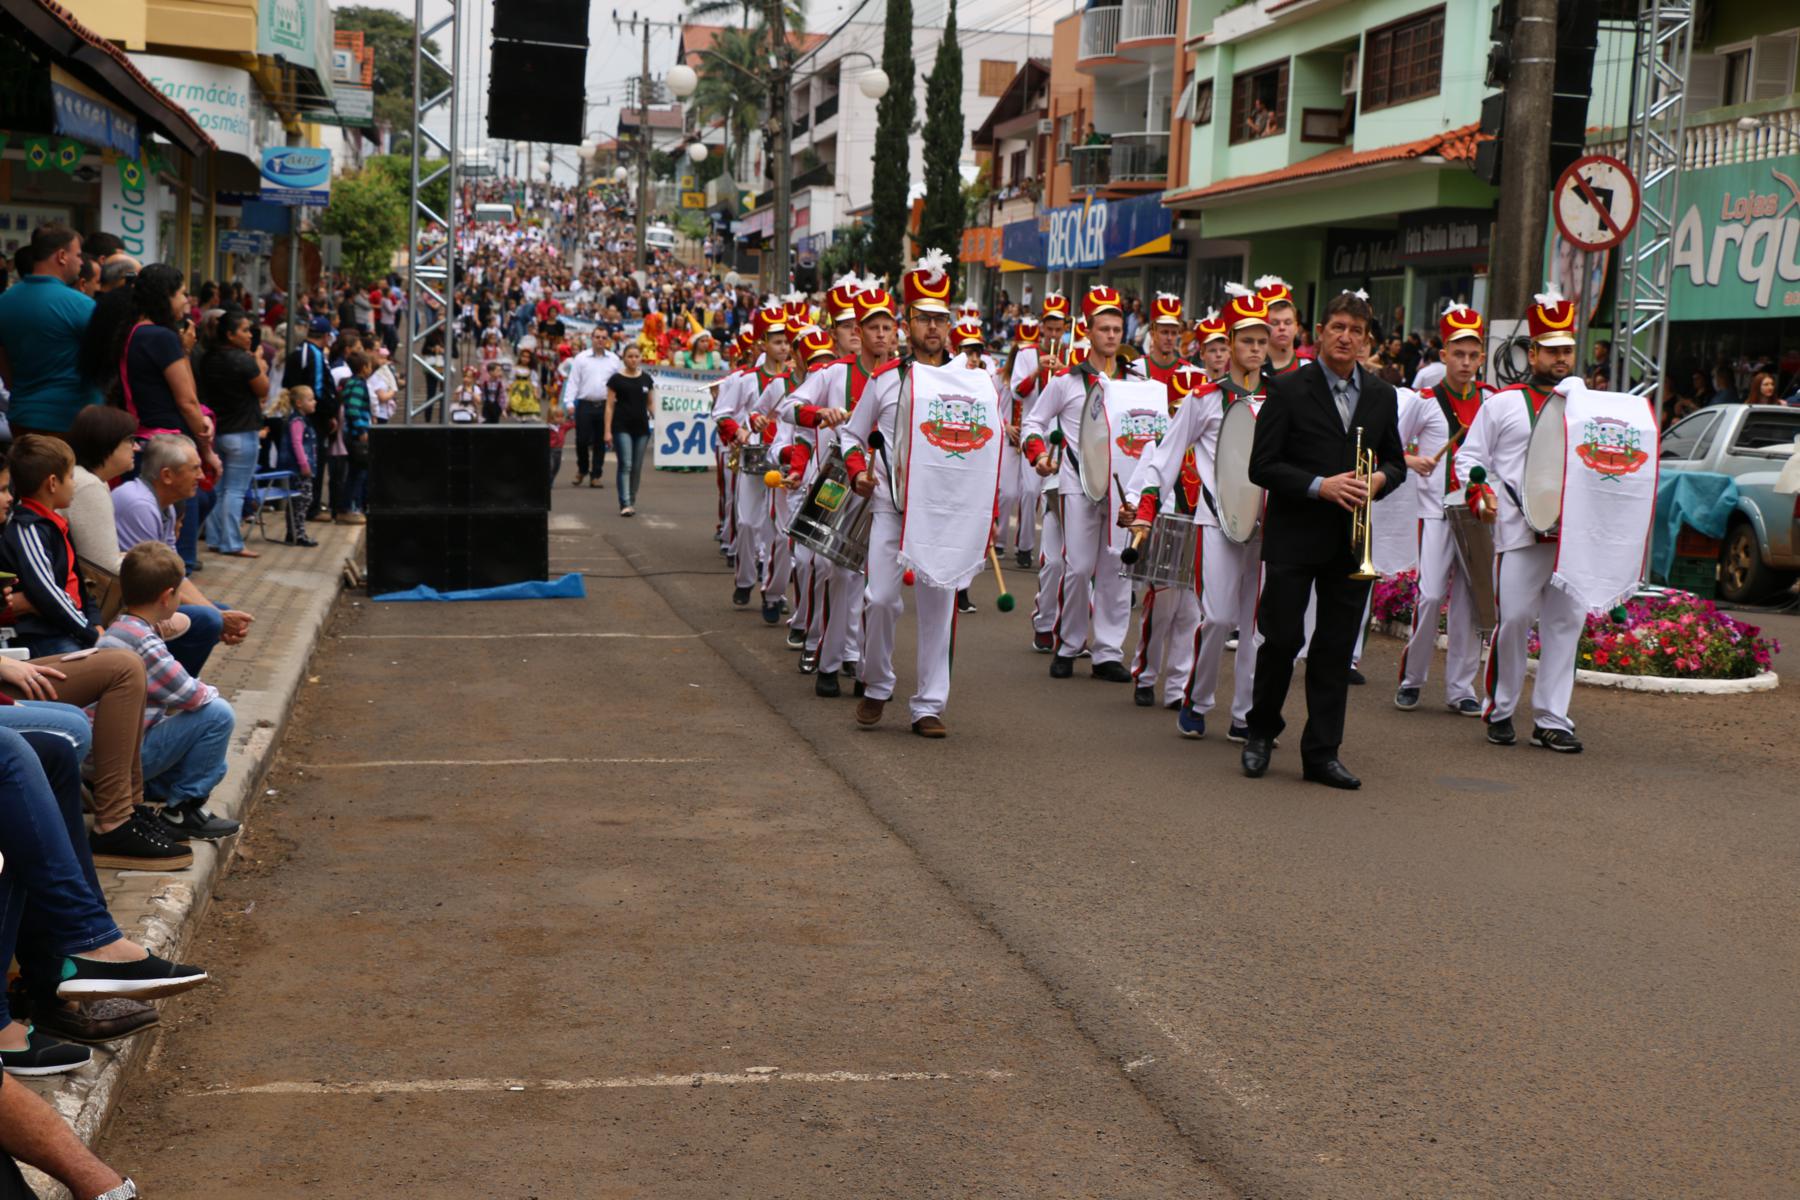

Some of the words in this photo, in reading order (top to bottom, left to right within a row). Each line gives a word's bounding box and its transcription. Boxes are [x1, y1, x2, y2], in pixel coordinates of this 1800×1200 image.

[1721, 190, 1778, 225] Lojas
[1047, 194, 1107, 267] BECKER
[662, 396, 702, 412] ESCOLA
